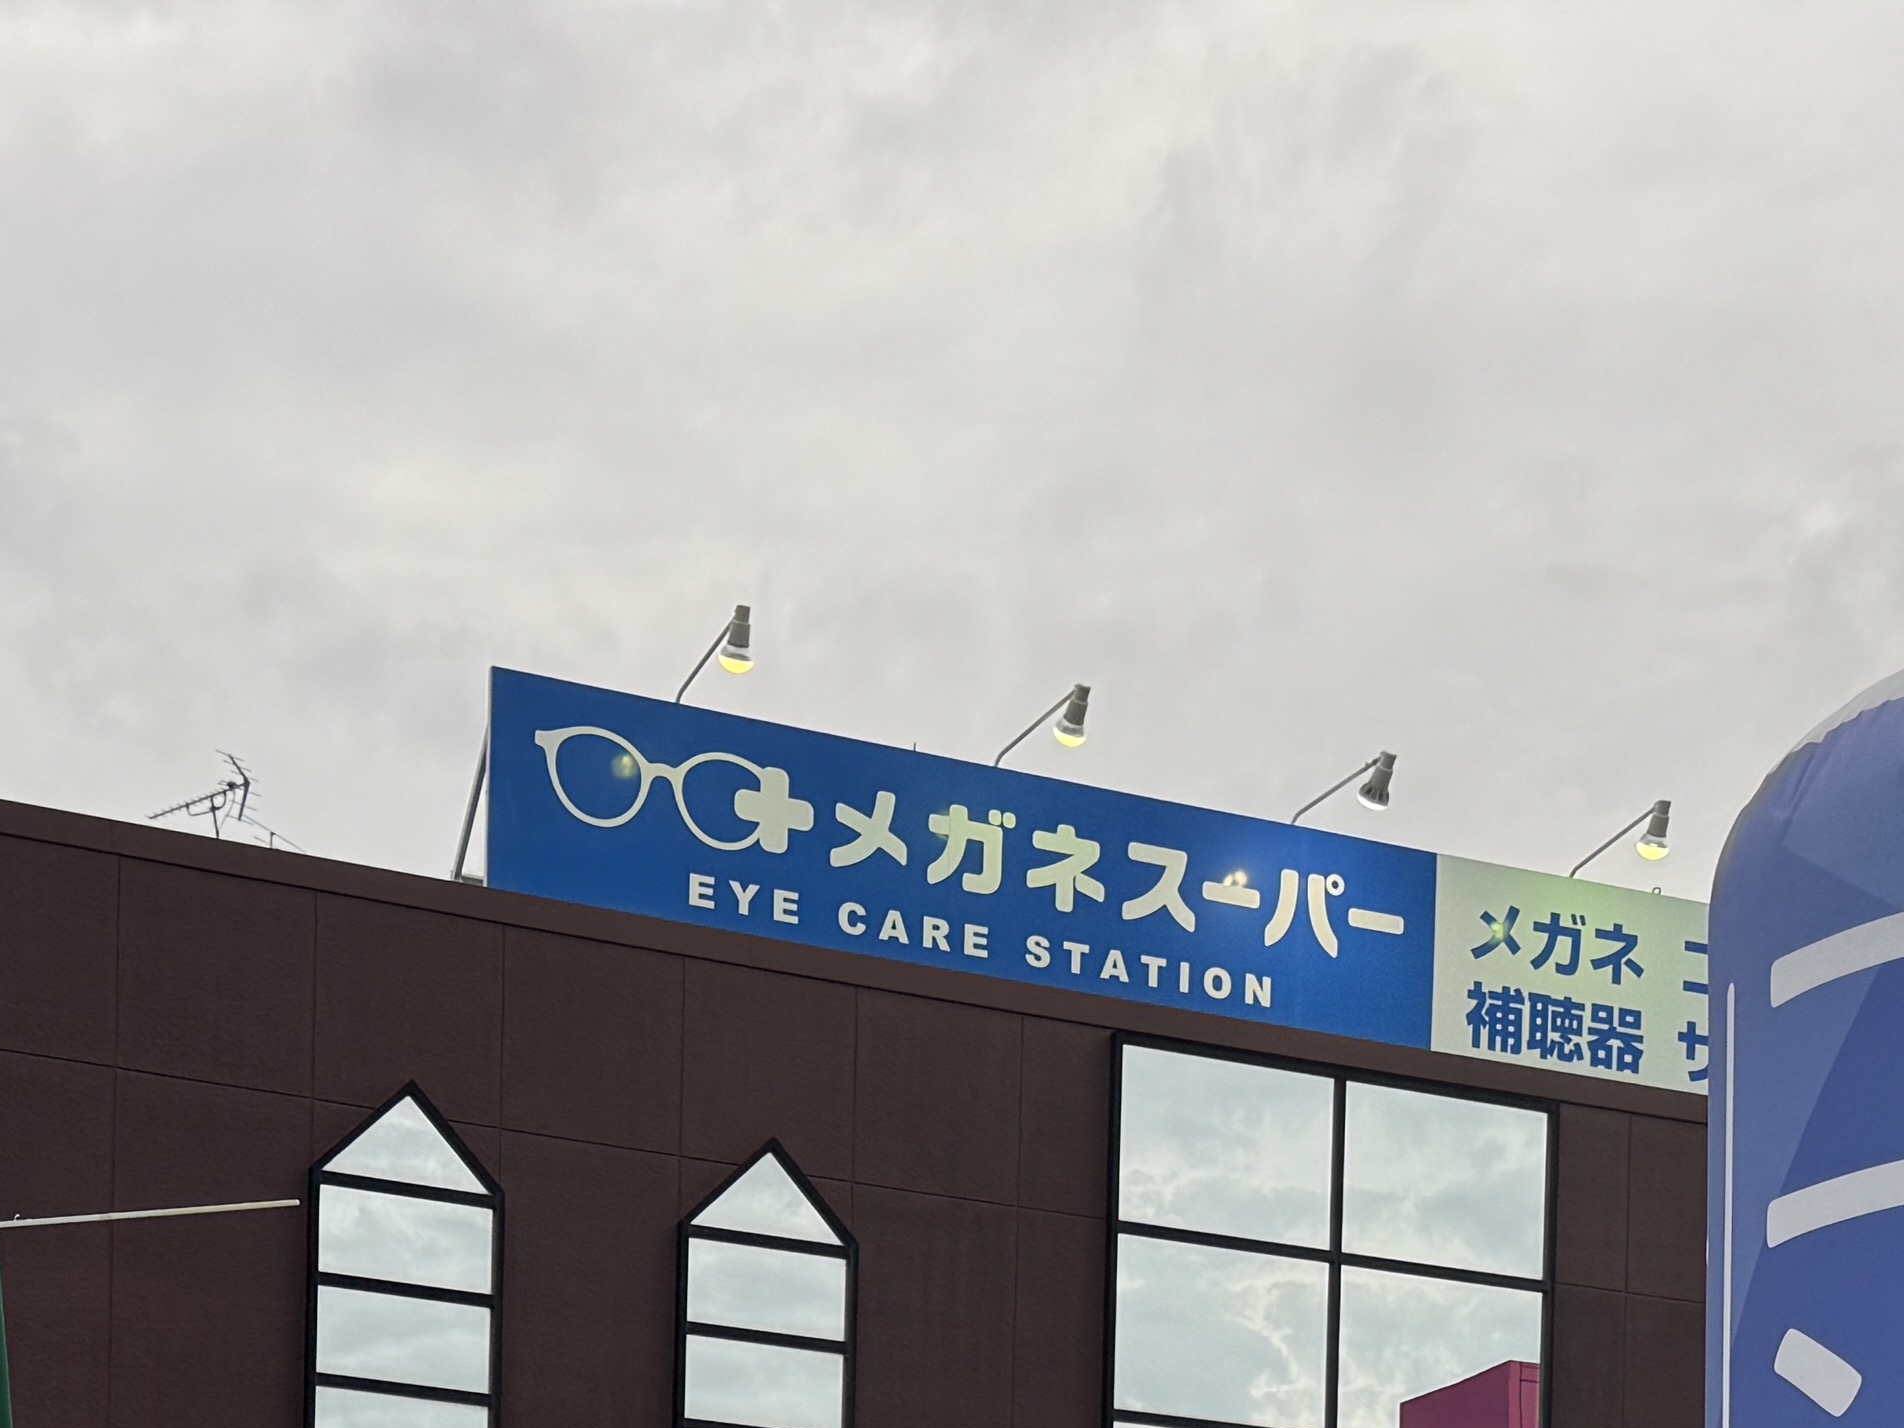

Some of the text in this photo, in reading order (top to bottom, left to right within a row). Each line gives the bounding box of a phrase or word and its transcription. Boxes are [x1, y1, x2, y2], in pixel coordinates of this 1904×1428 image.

[830, 788, 1405, 959] メガネスーパー
[687, 872, 1274, 1009] EYE CARE STATION
[1470, 905, 1645, 986] メガネ
[1465, 980, 1644, 1075] 補聴器
